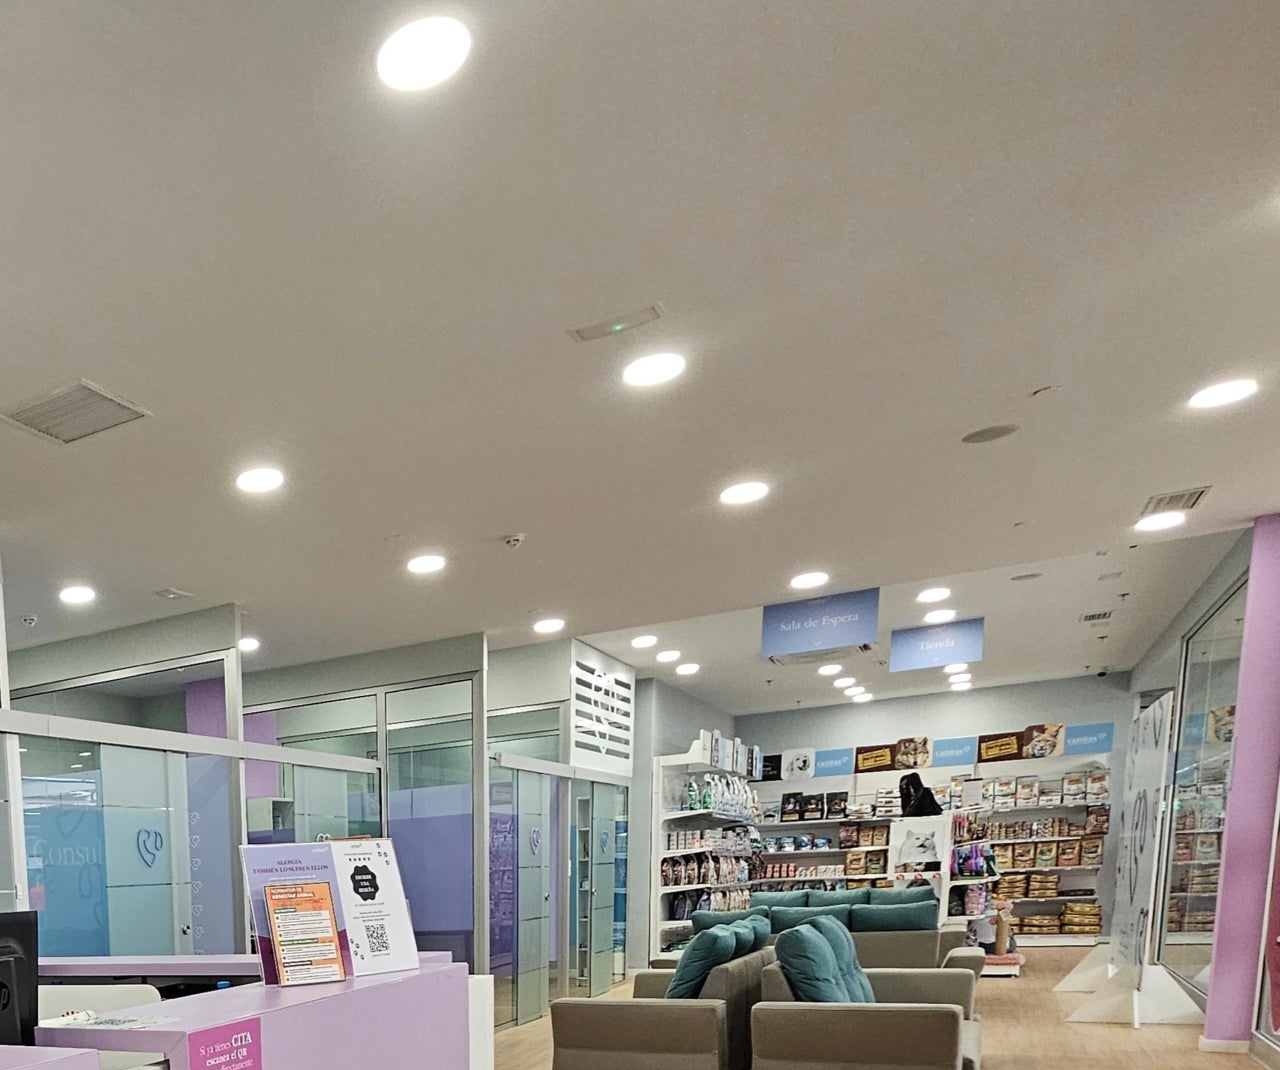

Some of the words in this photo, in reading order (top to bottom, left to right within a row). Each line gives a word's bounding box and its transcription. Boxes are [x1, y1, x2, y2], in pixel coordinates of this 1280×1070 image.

[779, 620, 800, 631] Sala
[804, 617, 819, 628] de
[822, 614, 859, 627] Espera
[918, 638, 955, 650] Tienda
[231, 1031, 252, 1047] CITA
[206, 1054, 231, 1067] escanea
[231, 1049, 237, 1060] el
[237, 1047, 248, 1060] QR
